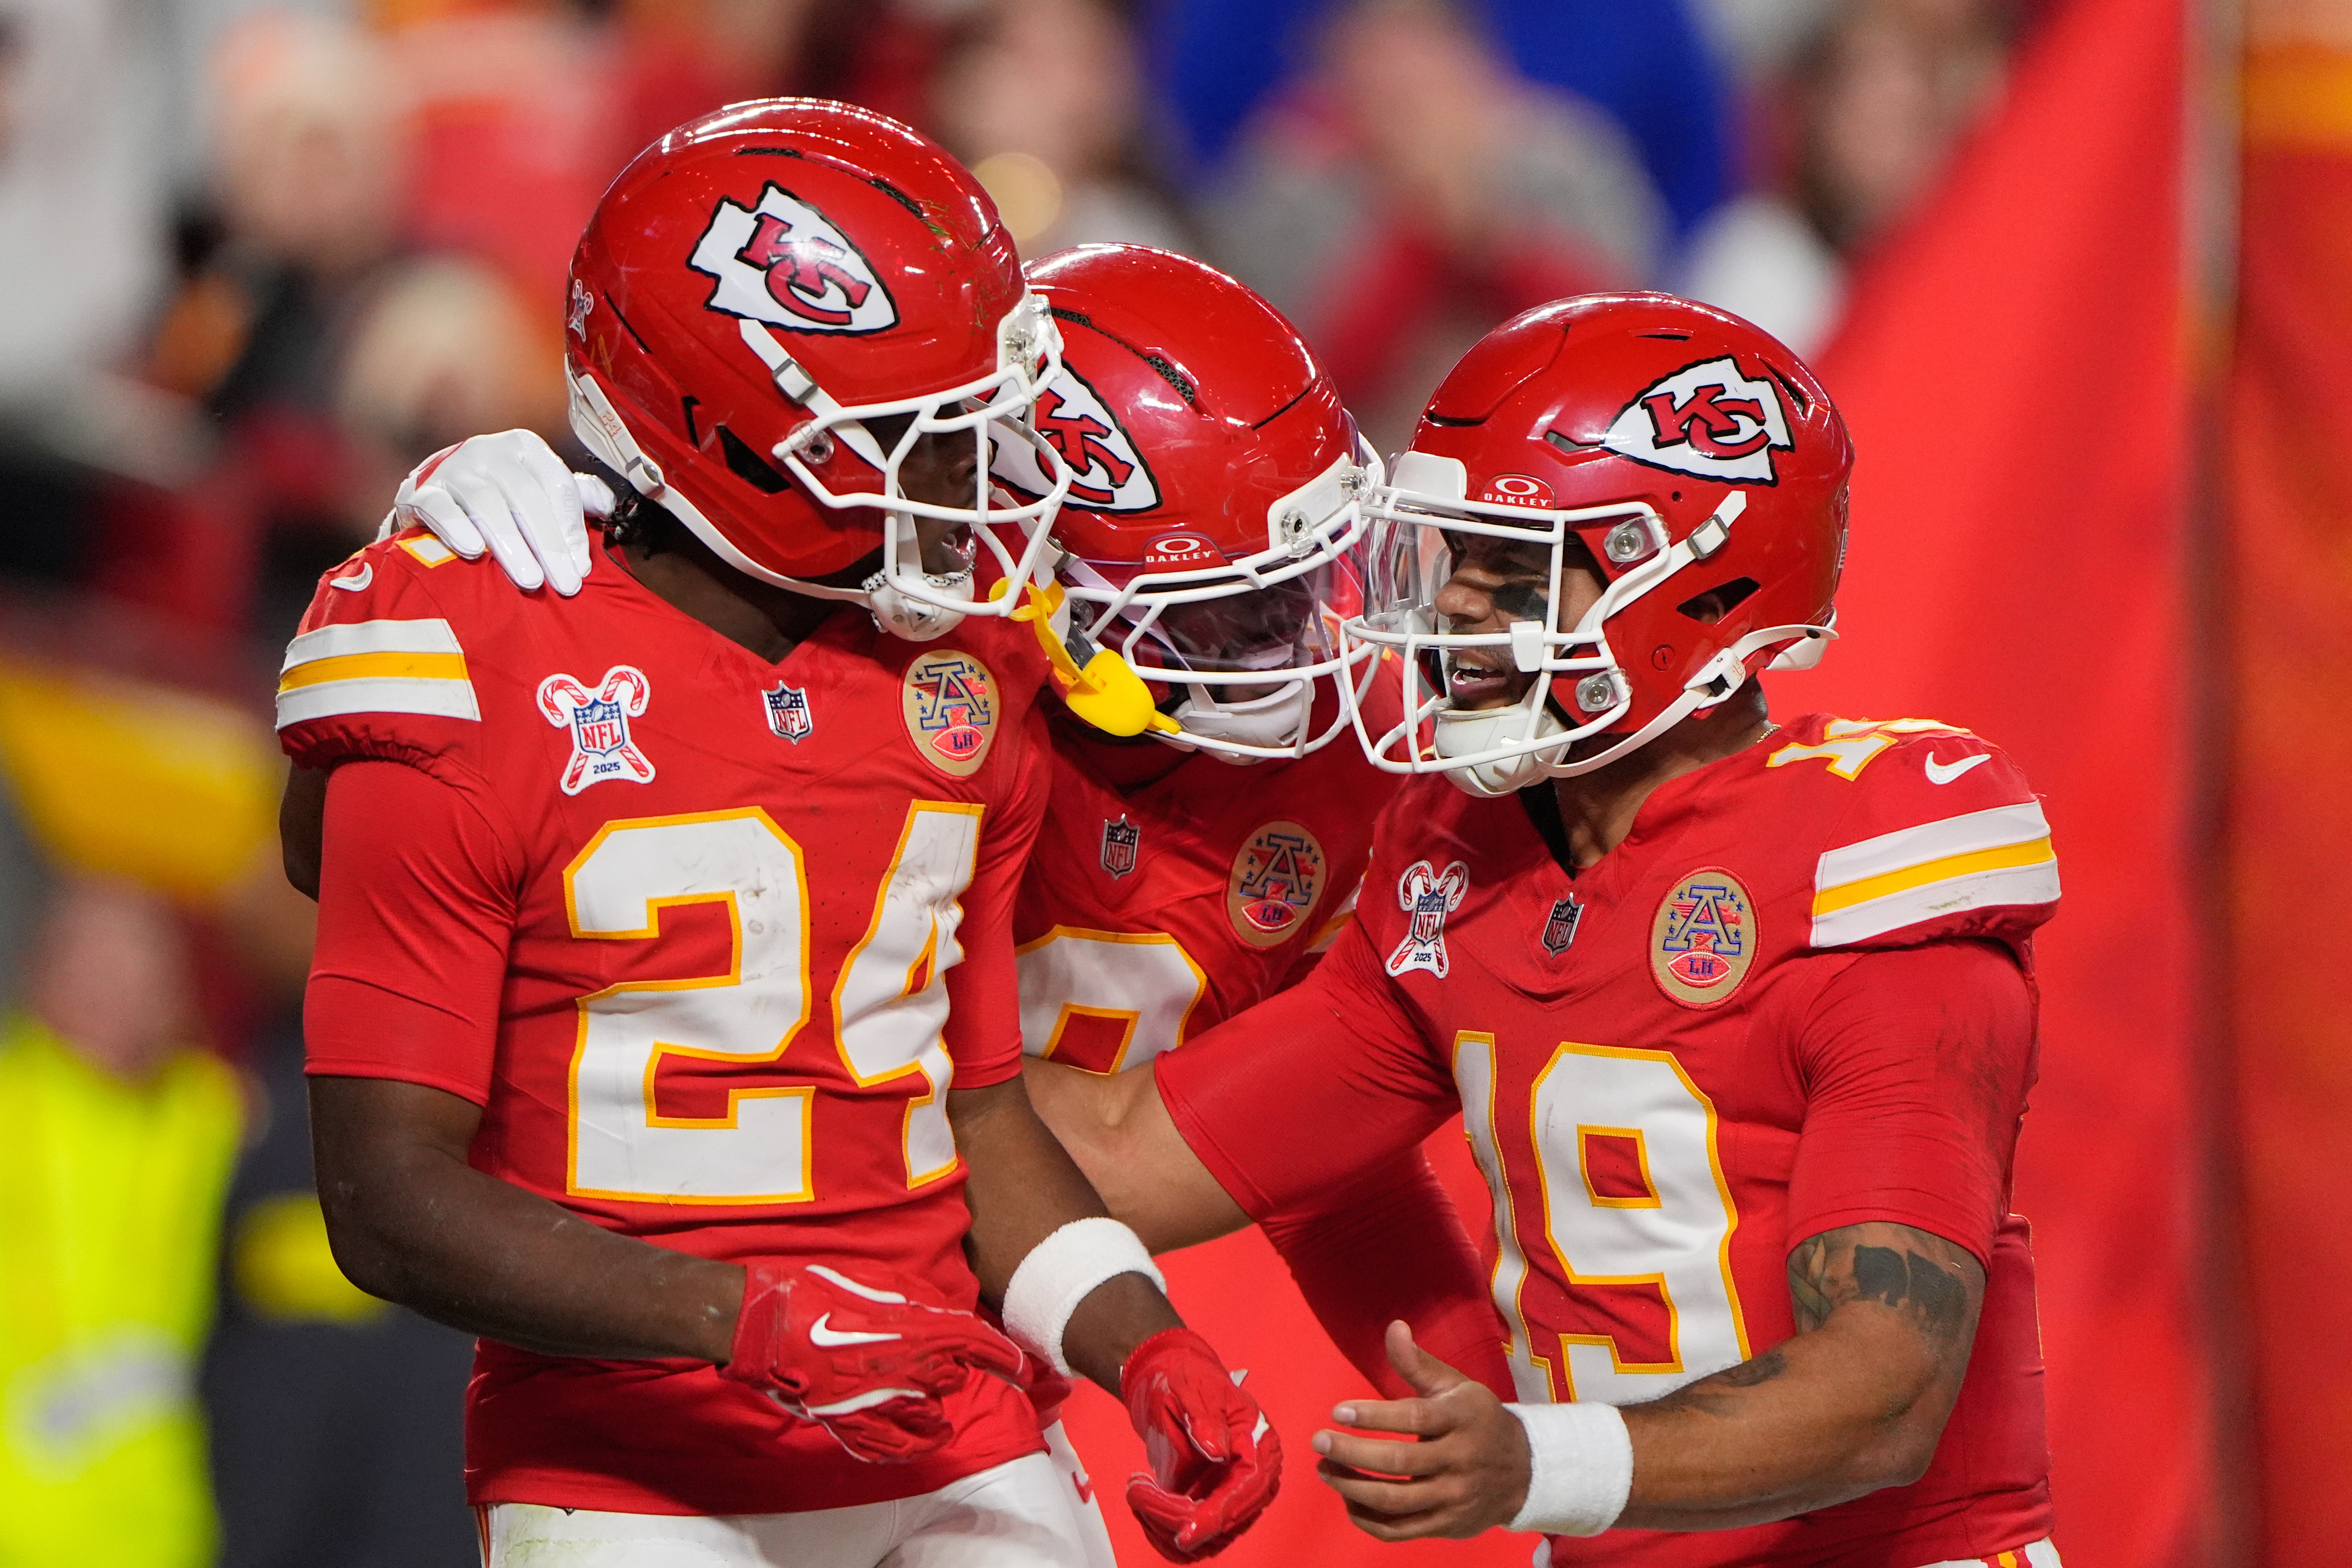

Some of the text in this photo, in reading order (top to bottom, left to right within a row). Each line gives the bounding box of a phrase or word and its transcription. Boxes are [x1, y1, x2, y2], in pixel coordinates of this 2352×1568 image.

[734, 212, 872, 325] KC
[599, 411, 622, 437] 24
[1640, 383, 1771, 459] KC
[1484, 493, 1549, 507] OAKLEY
[1146, 551, 1212, 563] OAKLEY
[920, 661, 991, 730] A
[775, 710, 806, 733] NFL
[581, 722, 621, 749] NFL
[952, 733, 973, 749] LH
[593, 761, 621, 775] 2025
[1107, 843, 1130, 869] NFL
[1239, 833, 1312, 905] A
[1260, 906, 1283, 923] LH
[1416, 914, 1438, 940] NFL
[1663, 885, 1742, 955] A
[1547, 921, 1570, 945] NFL
[1414, 952, 1432, 962] 2025
[1688, 959, 1715, 976] LH
[562, 798, 986, 1206] 24
[1454, 1029, 1752, 1405] 19
